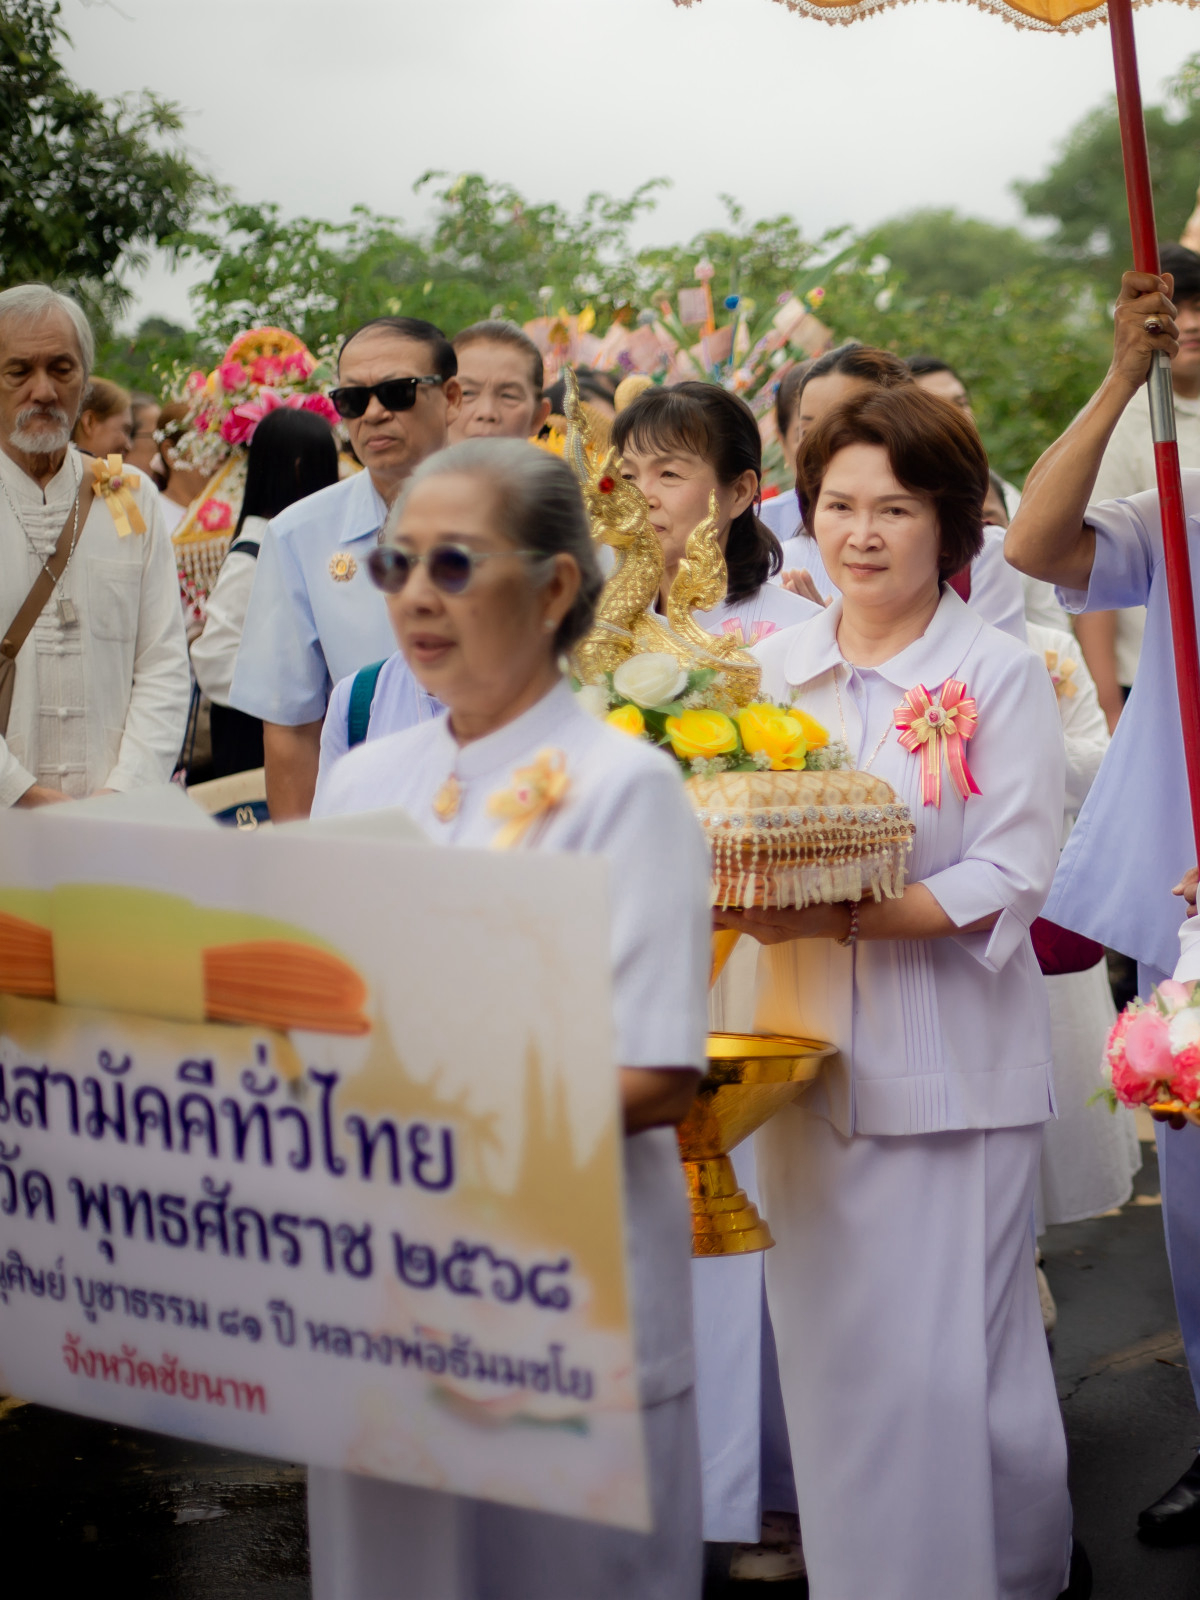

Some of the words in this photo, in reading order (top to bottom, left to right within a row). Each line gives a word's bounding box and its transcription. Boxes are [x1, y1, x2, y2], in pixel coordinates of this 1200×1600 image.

[68, 1176, 373, 1280] พุทธศักราช
[391, 1231, 572, 1312] ๒๕๖๘
[74, 1276, 209, 1330] บูชาธรรม
[218, 1308, 263, 1343] ๘๑
[266, 1298, 296, 1347] ปี
[62, 1331, 268, 1415] จังหวัดชัยนาท
